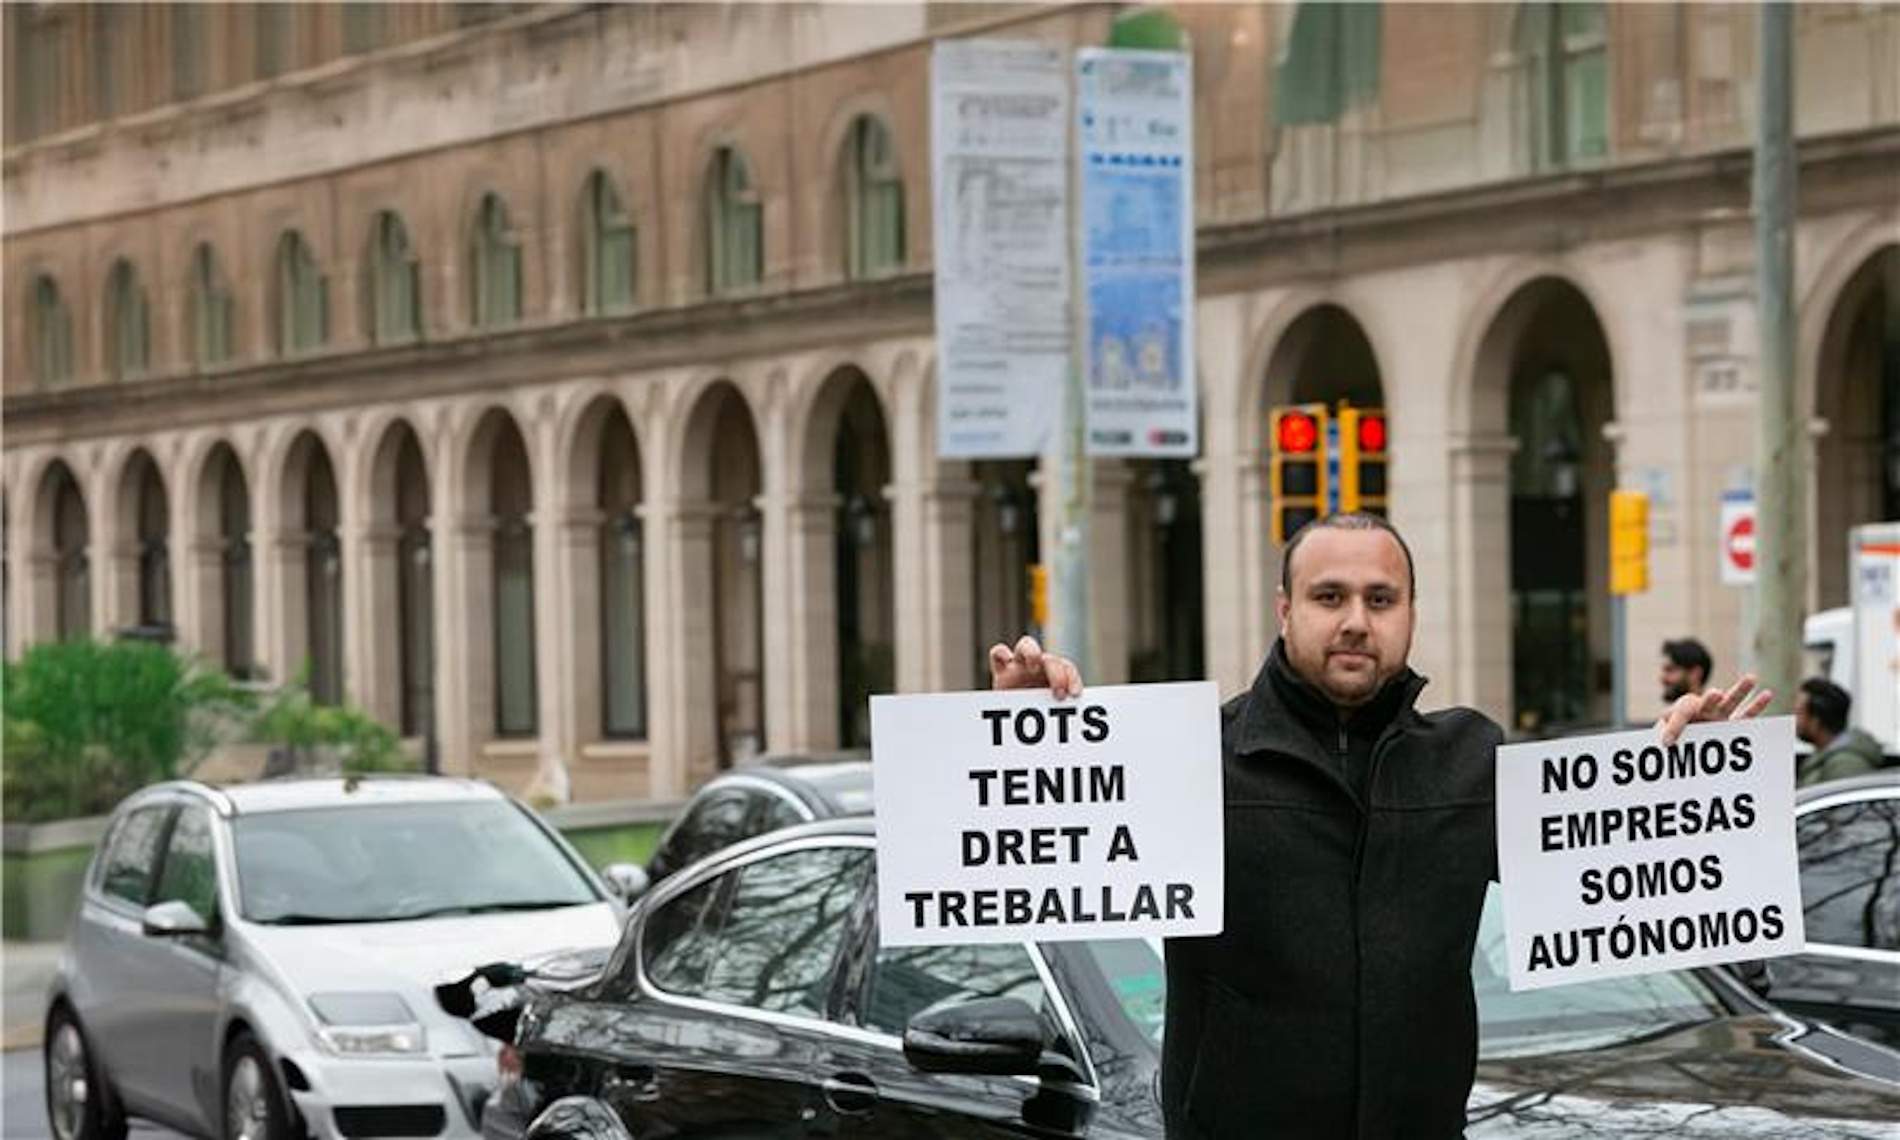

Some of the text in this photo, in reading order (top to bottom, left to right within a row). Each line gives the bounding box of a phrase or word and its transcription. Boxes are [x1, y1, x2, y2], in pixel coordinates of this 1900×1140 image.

[981, 705, 1110, 746] TOTS
[968, 764, 1125, 807] TENIM
[1542, 736, 1753, 794] NO SOMOS
[961, 824, 1139, 867] DRET A
[1541, 793, 1756, 853] EMPRESAS
[1580, 854, 1723, 906] SOMOS
[904, 883, 1195, 929] TREBALLAR
[1527, 904, 1784, 972] AUTÓNOMOS
